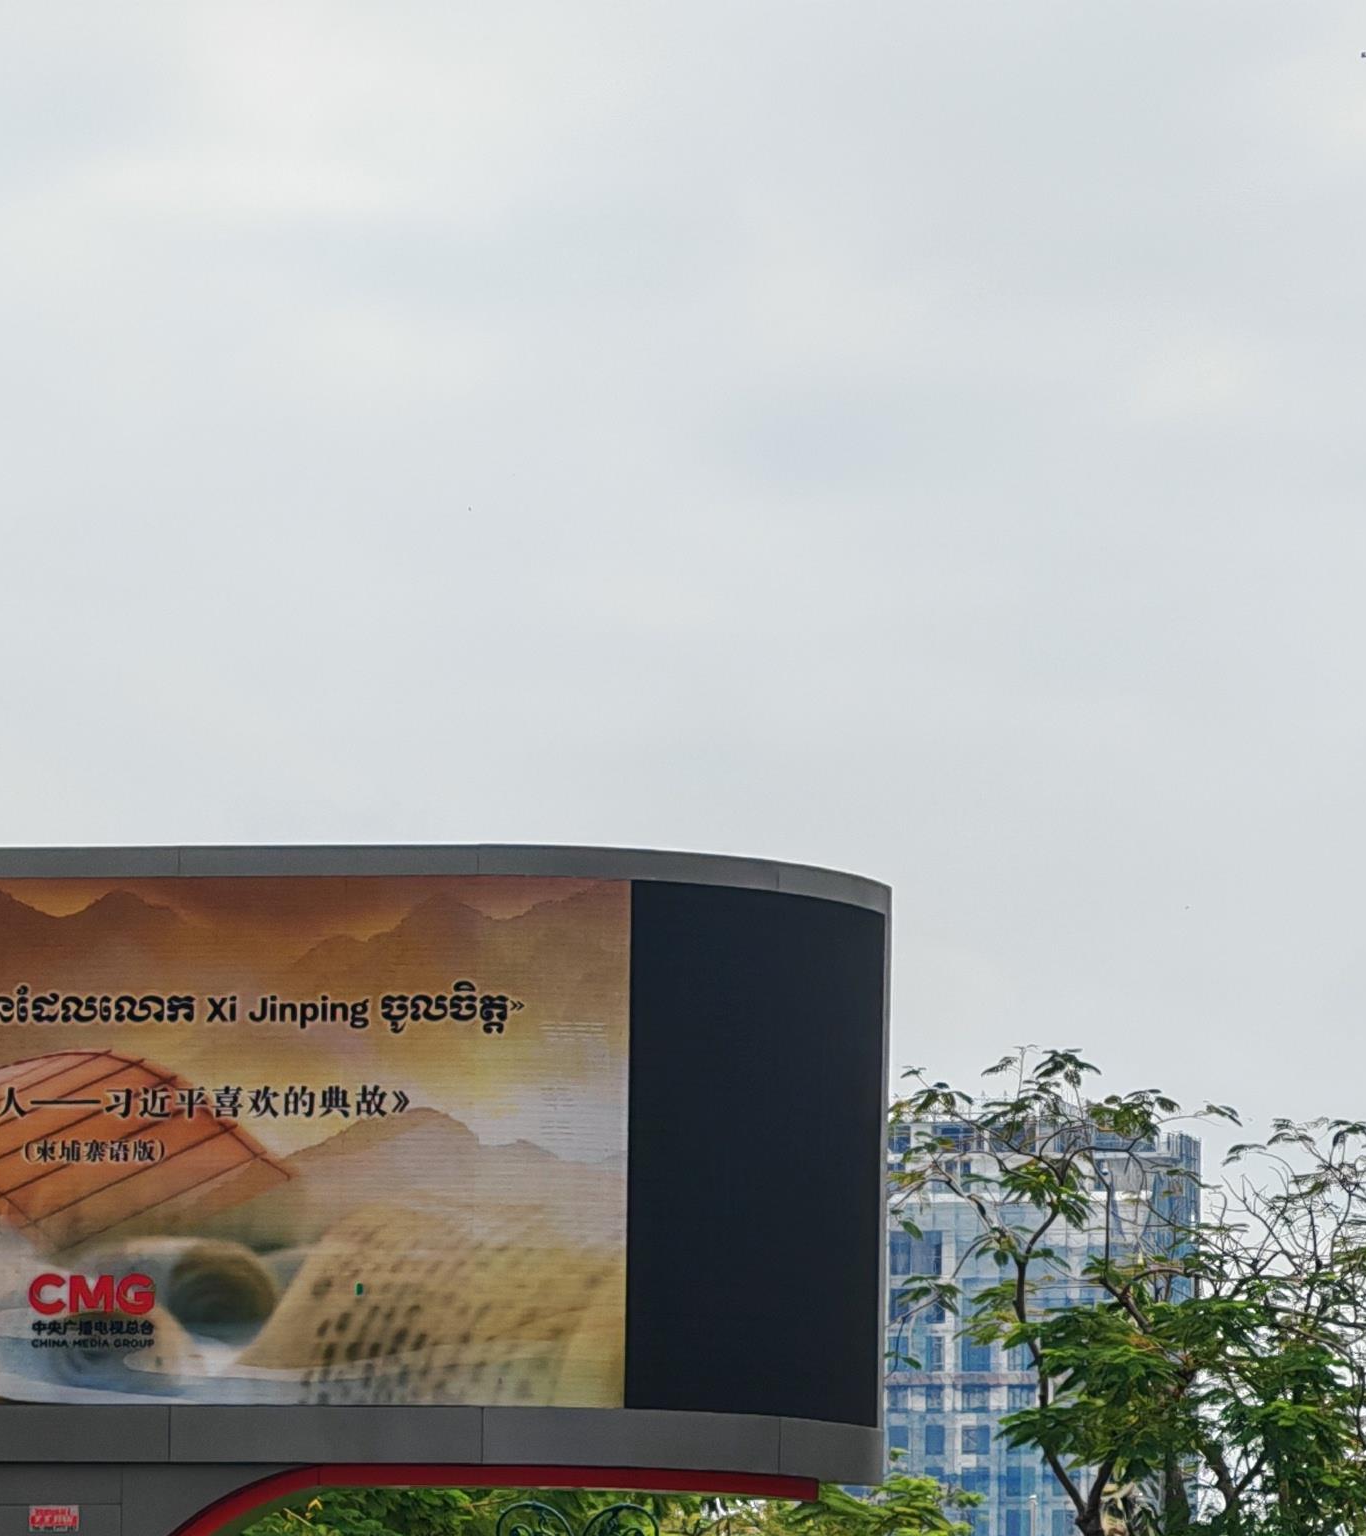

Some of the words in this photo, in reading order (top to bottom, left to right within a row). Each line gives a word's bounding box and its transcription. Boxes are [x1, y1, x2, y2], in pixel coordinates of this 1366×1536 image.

[206, 996, 236, 1022] Xi
[248, 996, 369, 1029] Jinping
[28, 1272, 156, 1315] CMG
[31, 1320, 155, 1335] 中央广播电视总台
[31, 1339, 68, 1349] CHINA
[73, 1339, 109, 1348] MEDIA
[113, 1339, 155, 1348] GROUP
